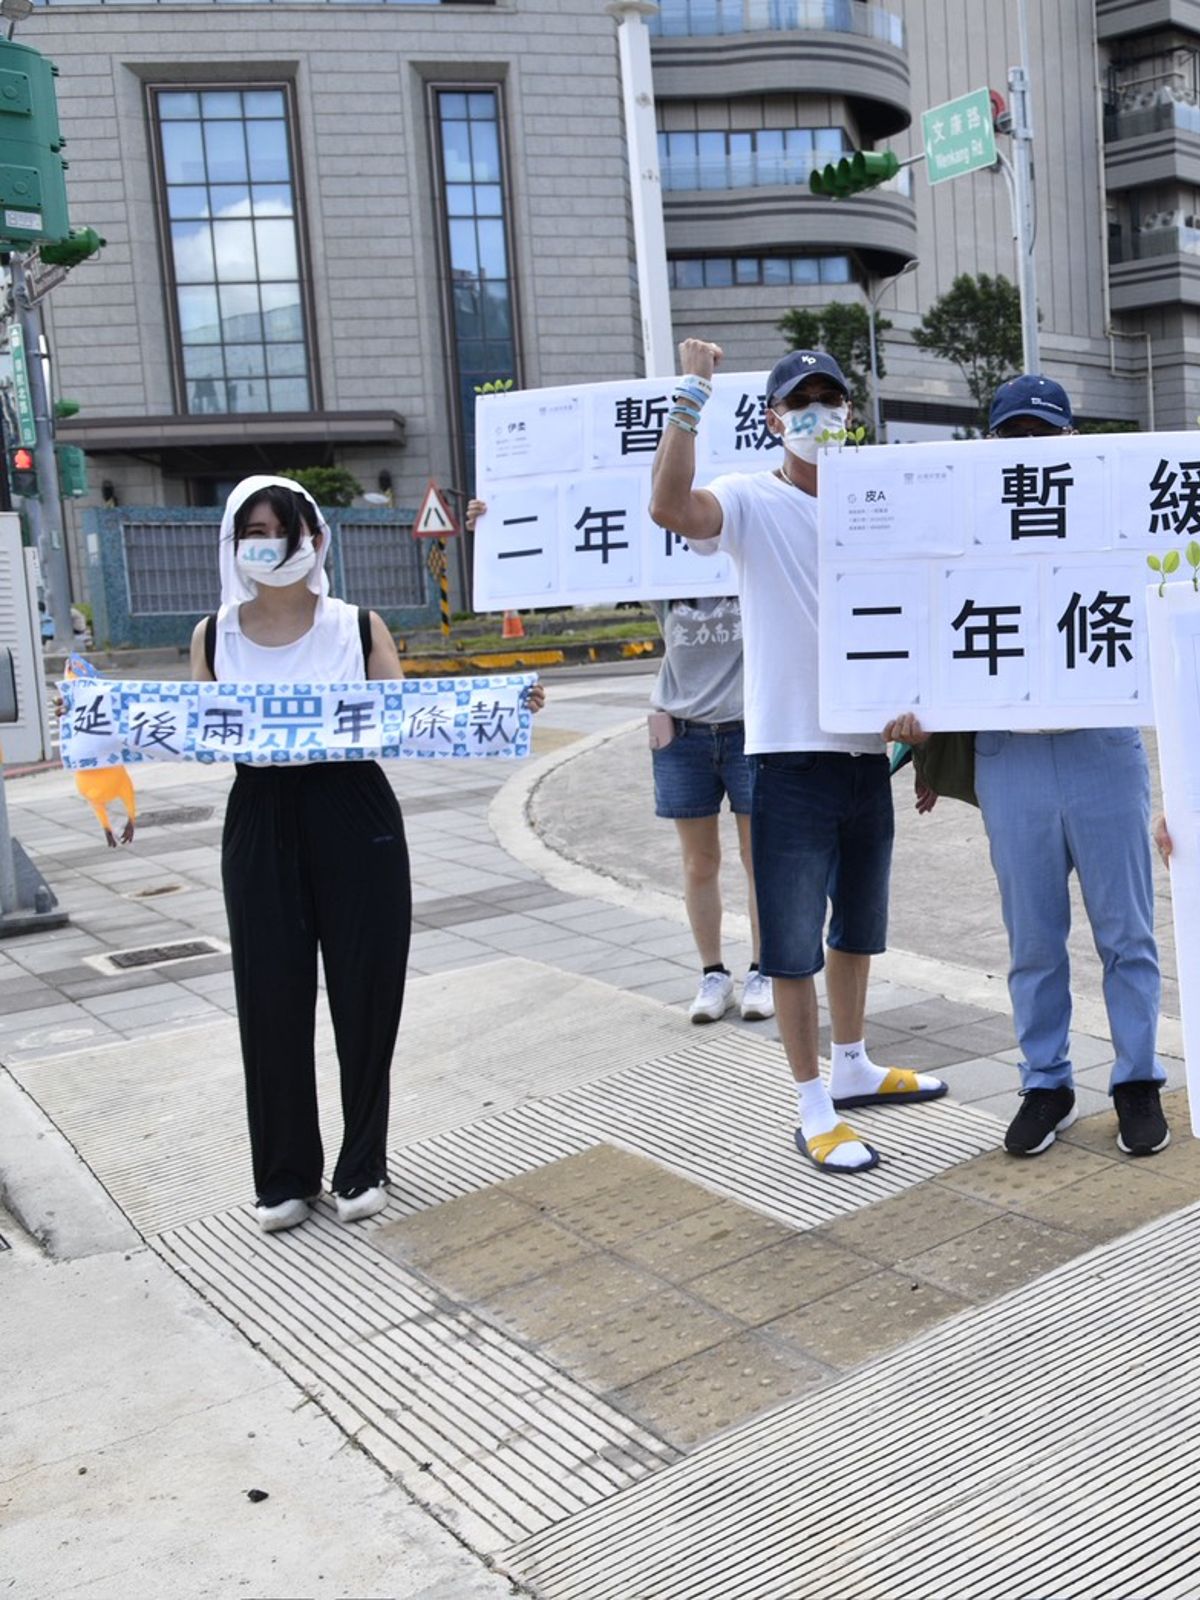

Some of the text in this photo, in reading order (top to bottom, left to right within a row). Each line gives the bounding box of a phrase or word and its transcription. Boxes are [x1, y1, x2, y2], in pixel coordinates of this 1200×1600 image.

[932, 106, 981, 144] 文康路
[846, 590, 1134, 676] 二年條
